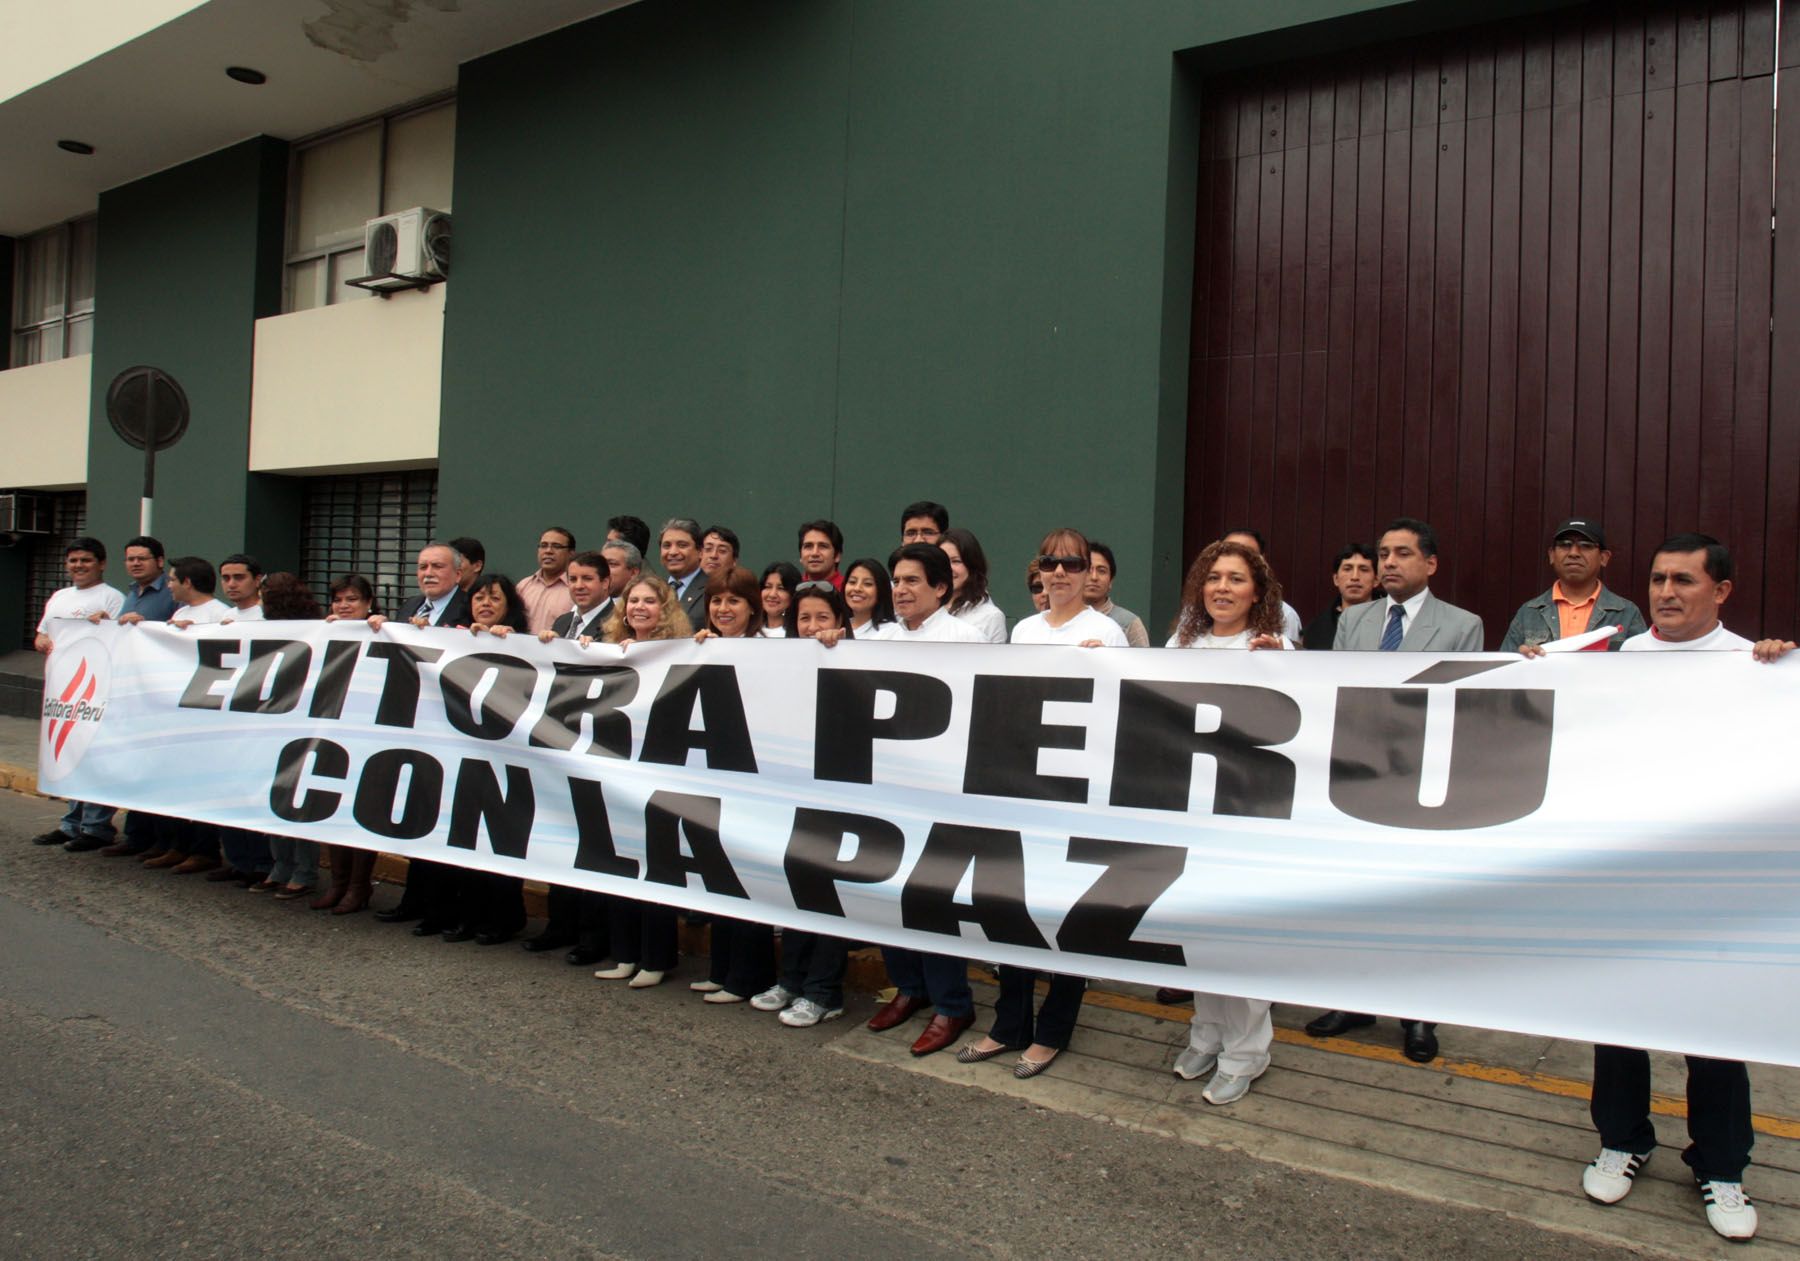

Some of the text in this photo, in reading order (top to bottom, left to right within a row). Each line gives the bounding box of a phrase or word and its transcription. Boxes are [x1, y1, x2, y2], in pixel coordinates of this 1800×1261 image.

[75, 700, 106, 722] Perú
[179, 638, 1556, 831] EDITORA PERÚ
[269, 737, 1188, 967] CON LA PAZ
